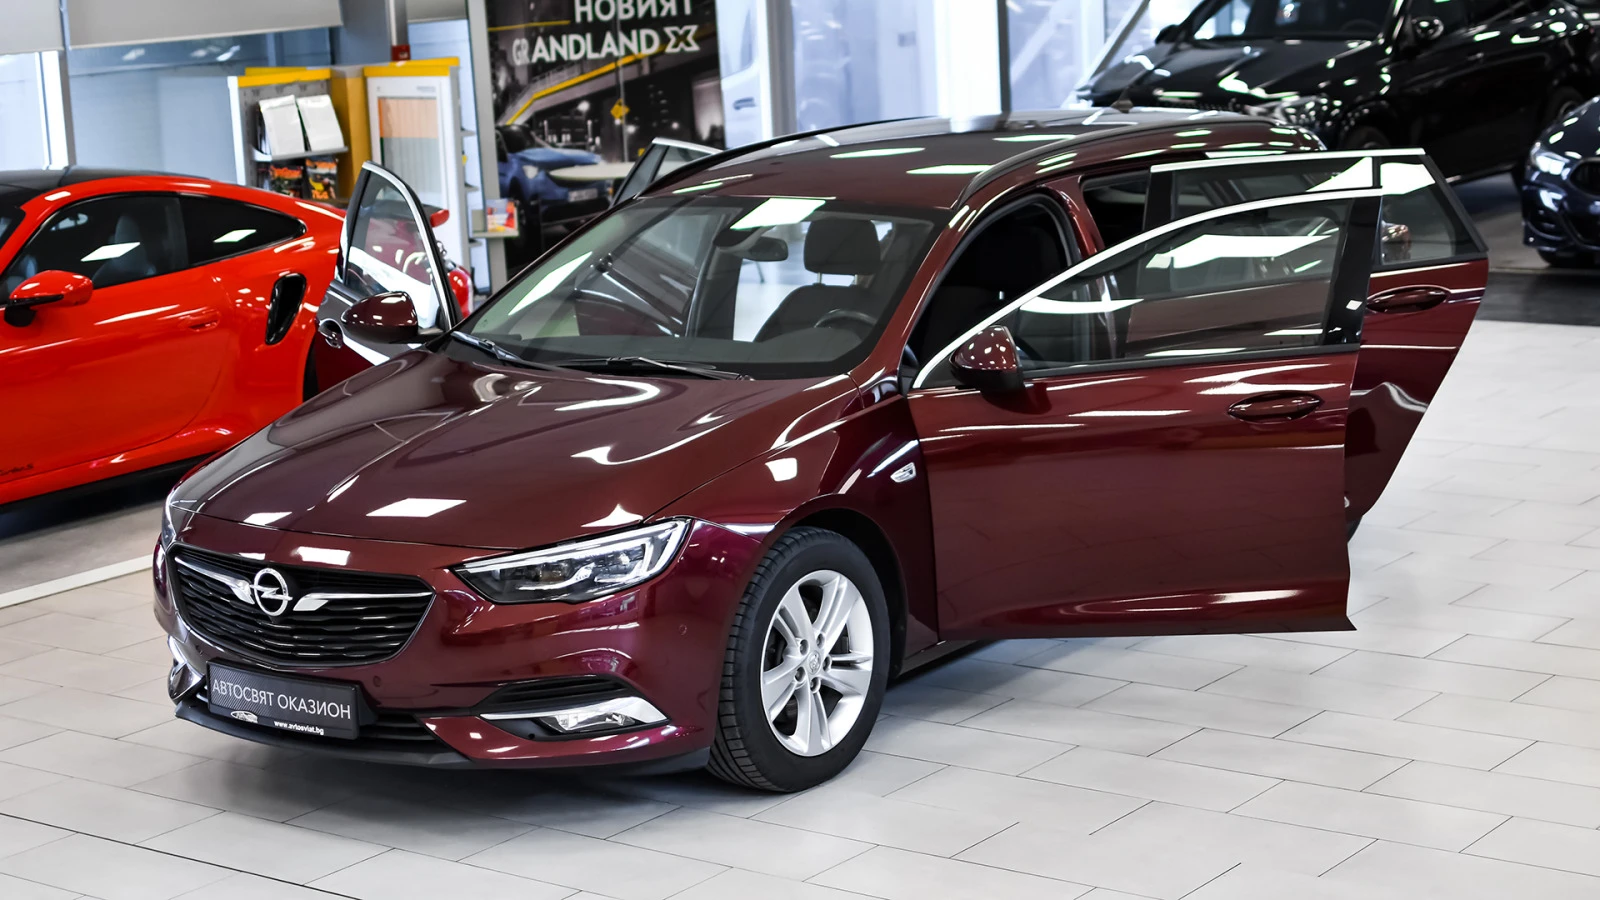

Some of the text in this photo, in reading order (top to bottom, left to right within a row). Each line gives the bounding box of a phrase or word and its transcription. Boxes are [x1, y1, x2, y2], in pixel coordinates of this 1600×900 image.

[512, 25, 700, 66] GRANDLAND X
[212, 680, 351, 719] АВТОСВЯТ ОКАЗИОН
